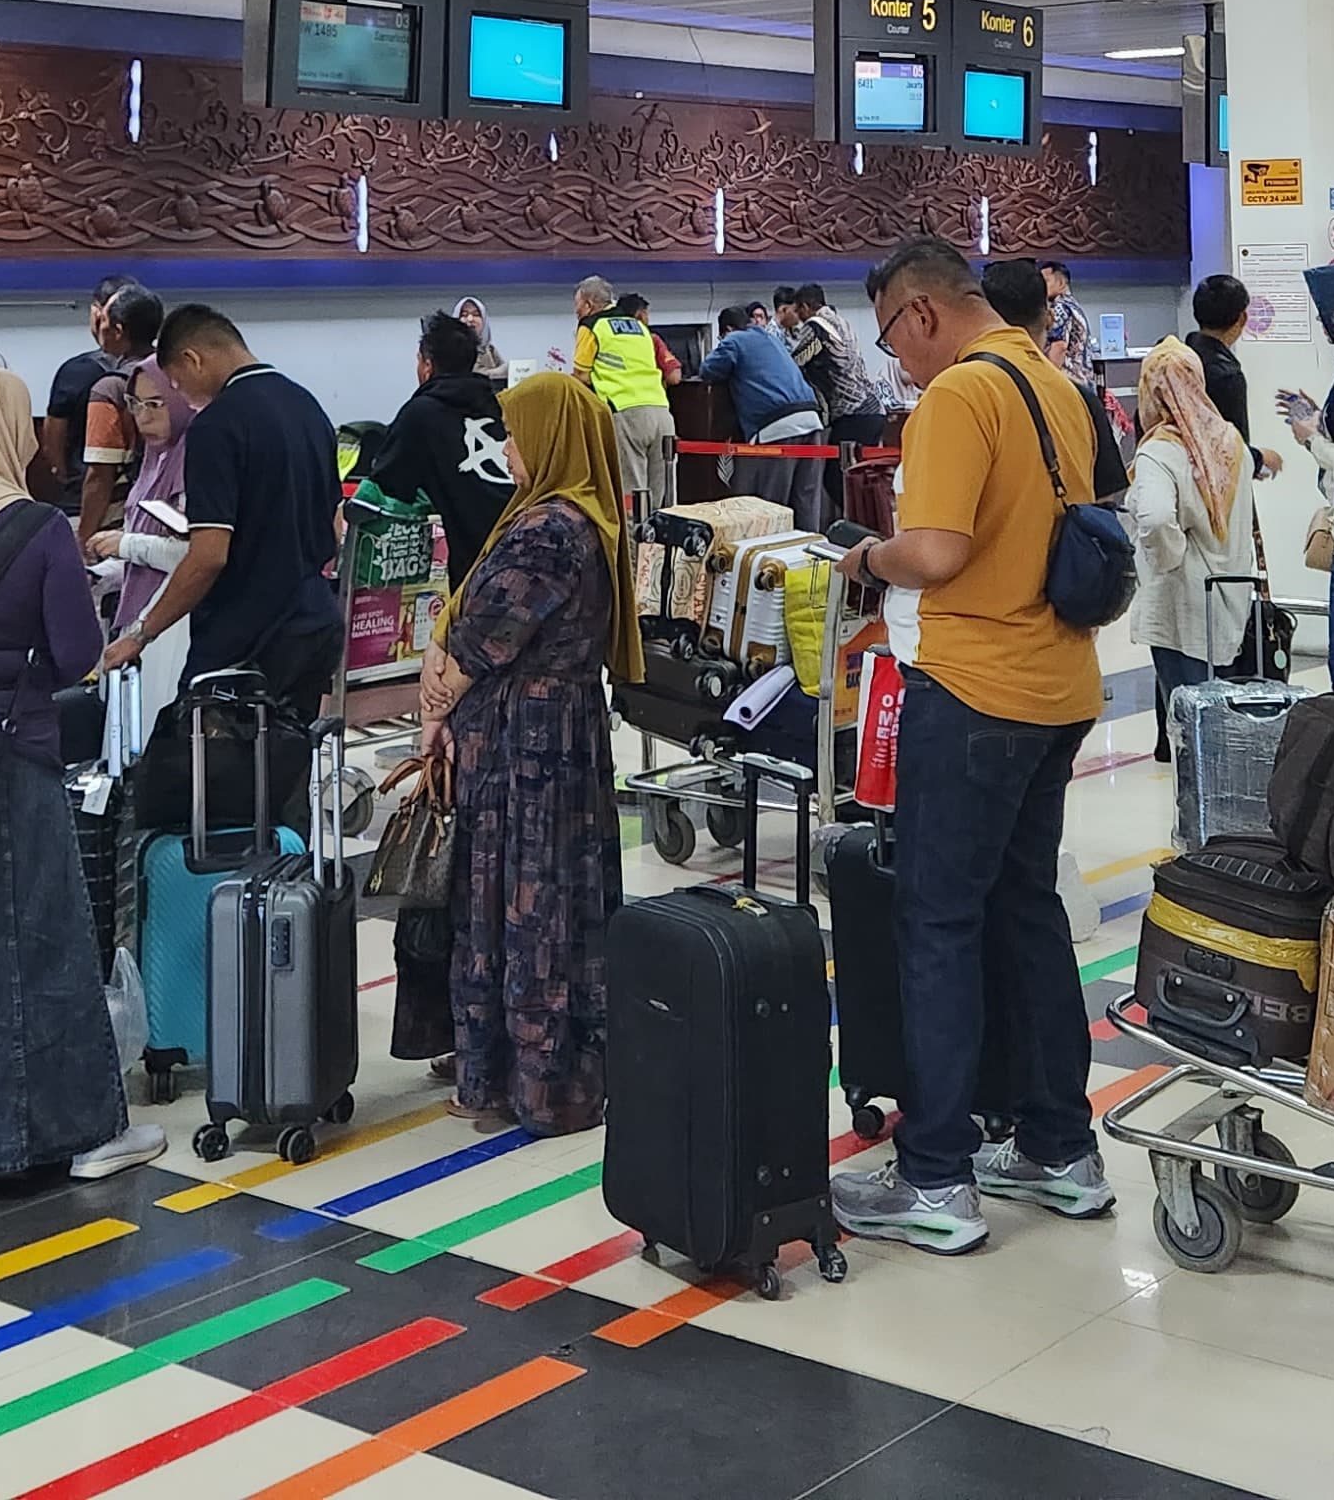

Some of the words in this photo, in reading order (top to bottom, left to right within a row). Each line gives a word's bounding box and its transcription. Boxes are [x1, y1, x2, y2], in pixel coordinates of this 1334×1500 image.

[887, 24, 910, 35] Counter
[981, 10, 1016, 34] Konter
[1023, 16, 1034, 47] 6
[912, 65, 924, 78] 05
[380, 555, 428, 580] BAGS
[352, 615, 395, 631] HEALING
